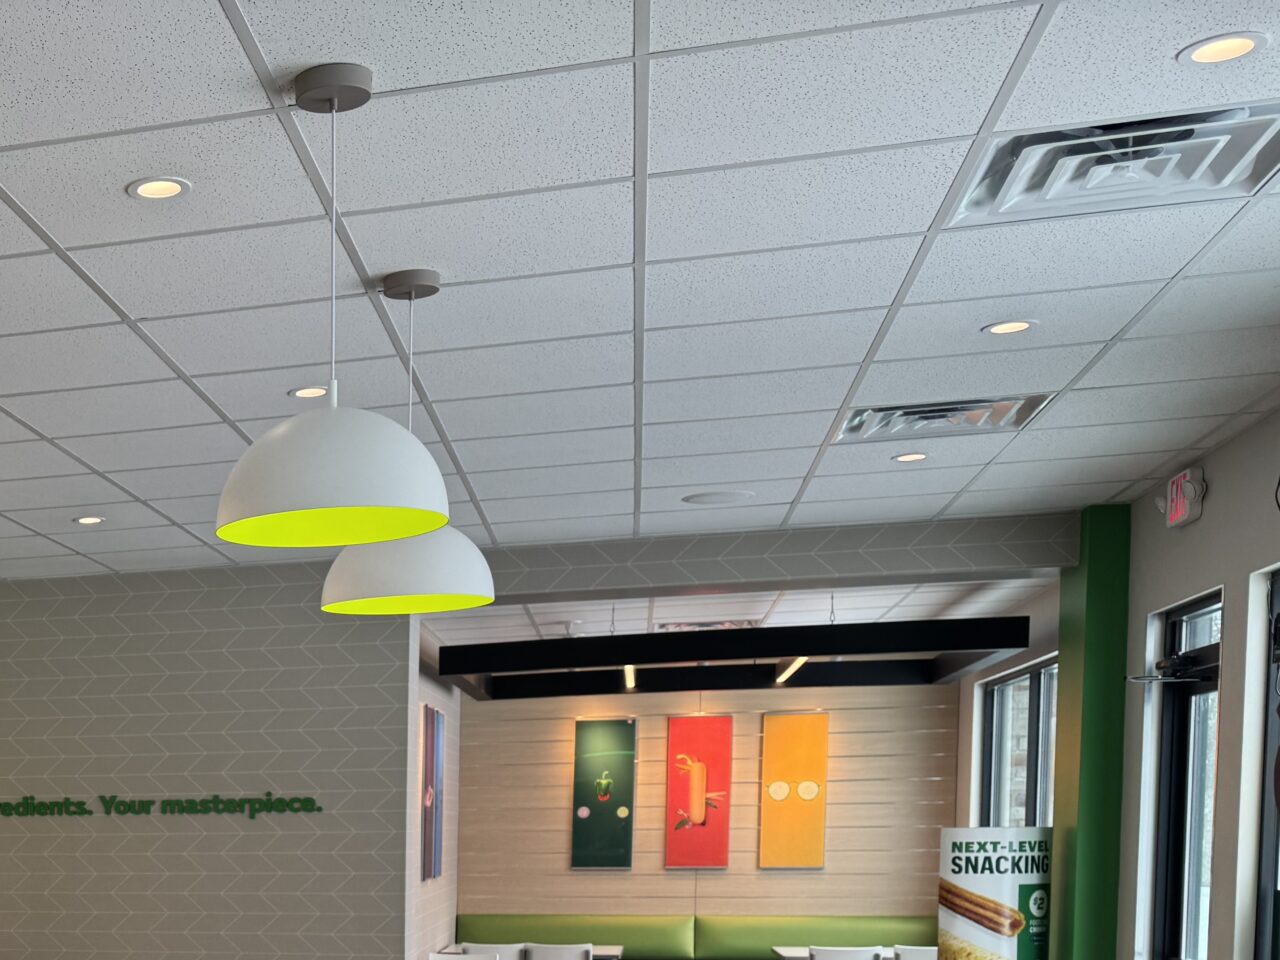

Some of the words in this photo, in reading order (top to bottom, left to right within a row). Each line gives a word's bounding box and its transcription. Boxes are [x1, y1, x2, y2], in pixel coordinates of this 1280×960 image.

[98, 795, 155, 816] Your
[160, 791, 324, 820] masterpiece.
[951, 840, 1049, 854] NEXT-LEVEL
[950, 854, 1050, 874] SNACKING
[1033, 896, 1045, 911] $2
